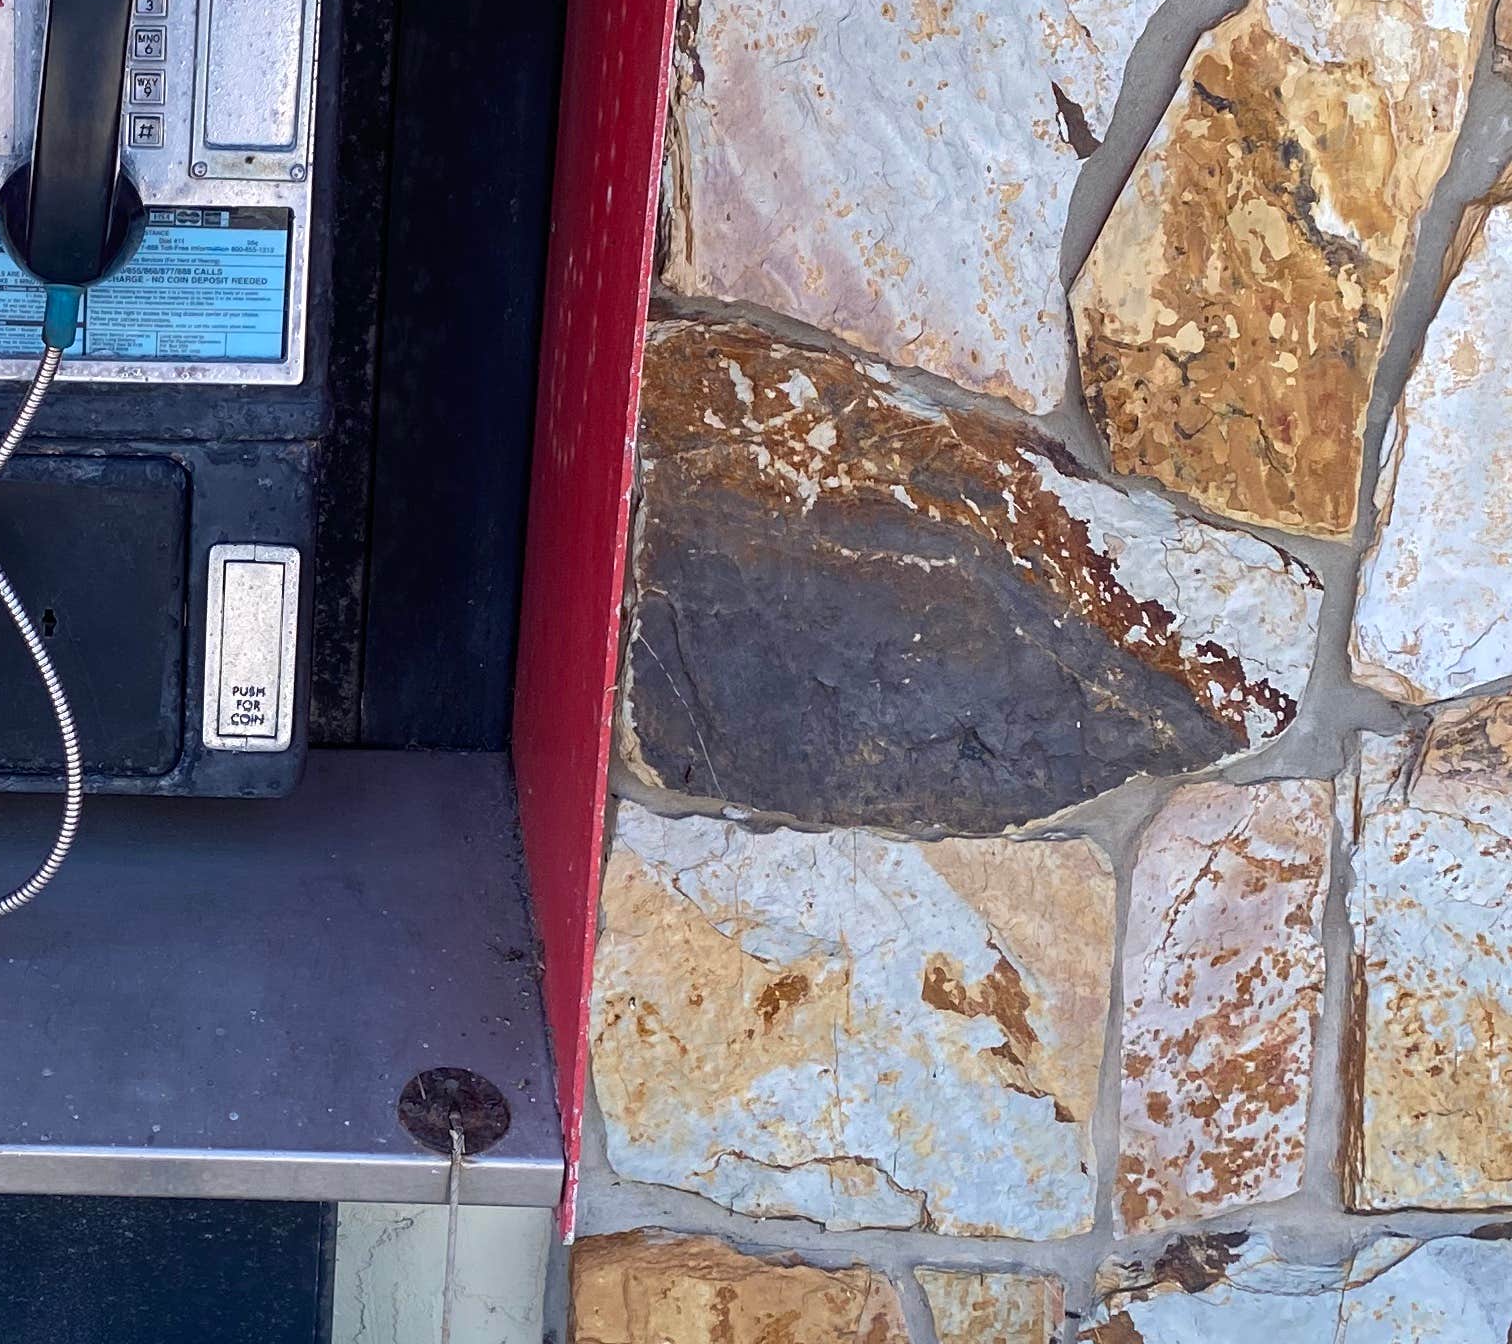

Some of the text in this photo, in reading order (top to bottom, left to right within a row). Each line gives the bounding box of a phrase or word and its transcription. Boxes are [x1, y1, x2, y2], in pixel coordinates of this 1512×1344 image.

[138, 33, 160, 44] MNO
[144, 42, 154, 55] 6
[144, 84, 153, 98] 9
[232, 685, 266, 697] PUSH
[236, 699, 261, 712] FOR
[230, 712, 265, 726] COIN
